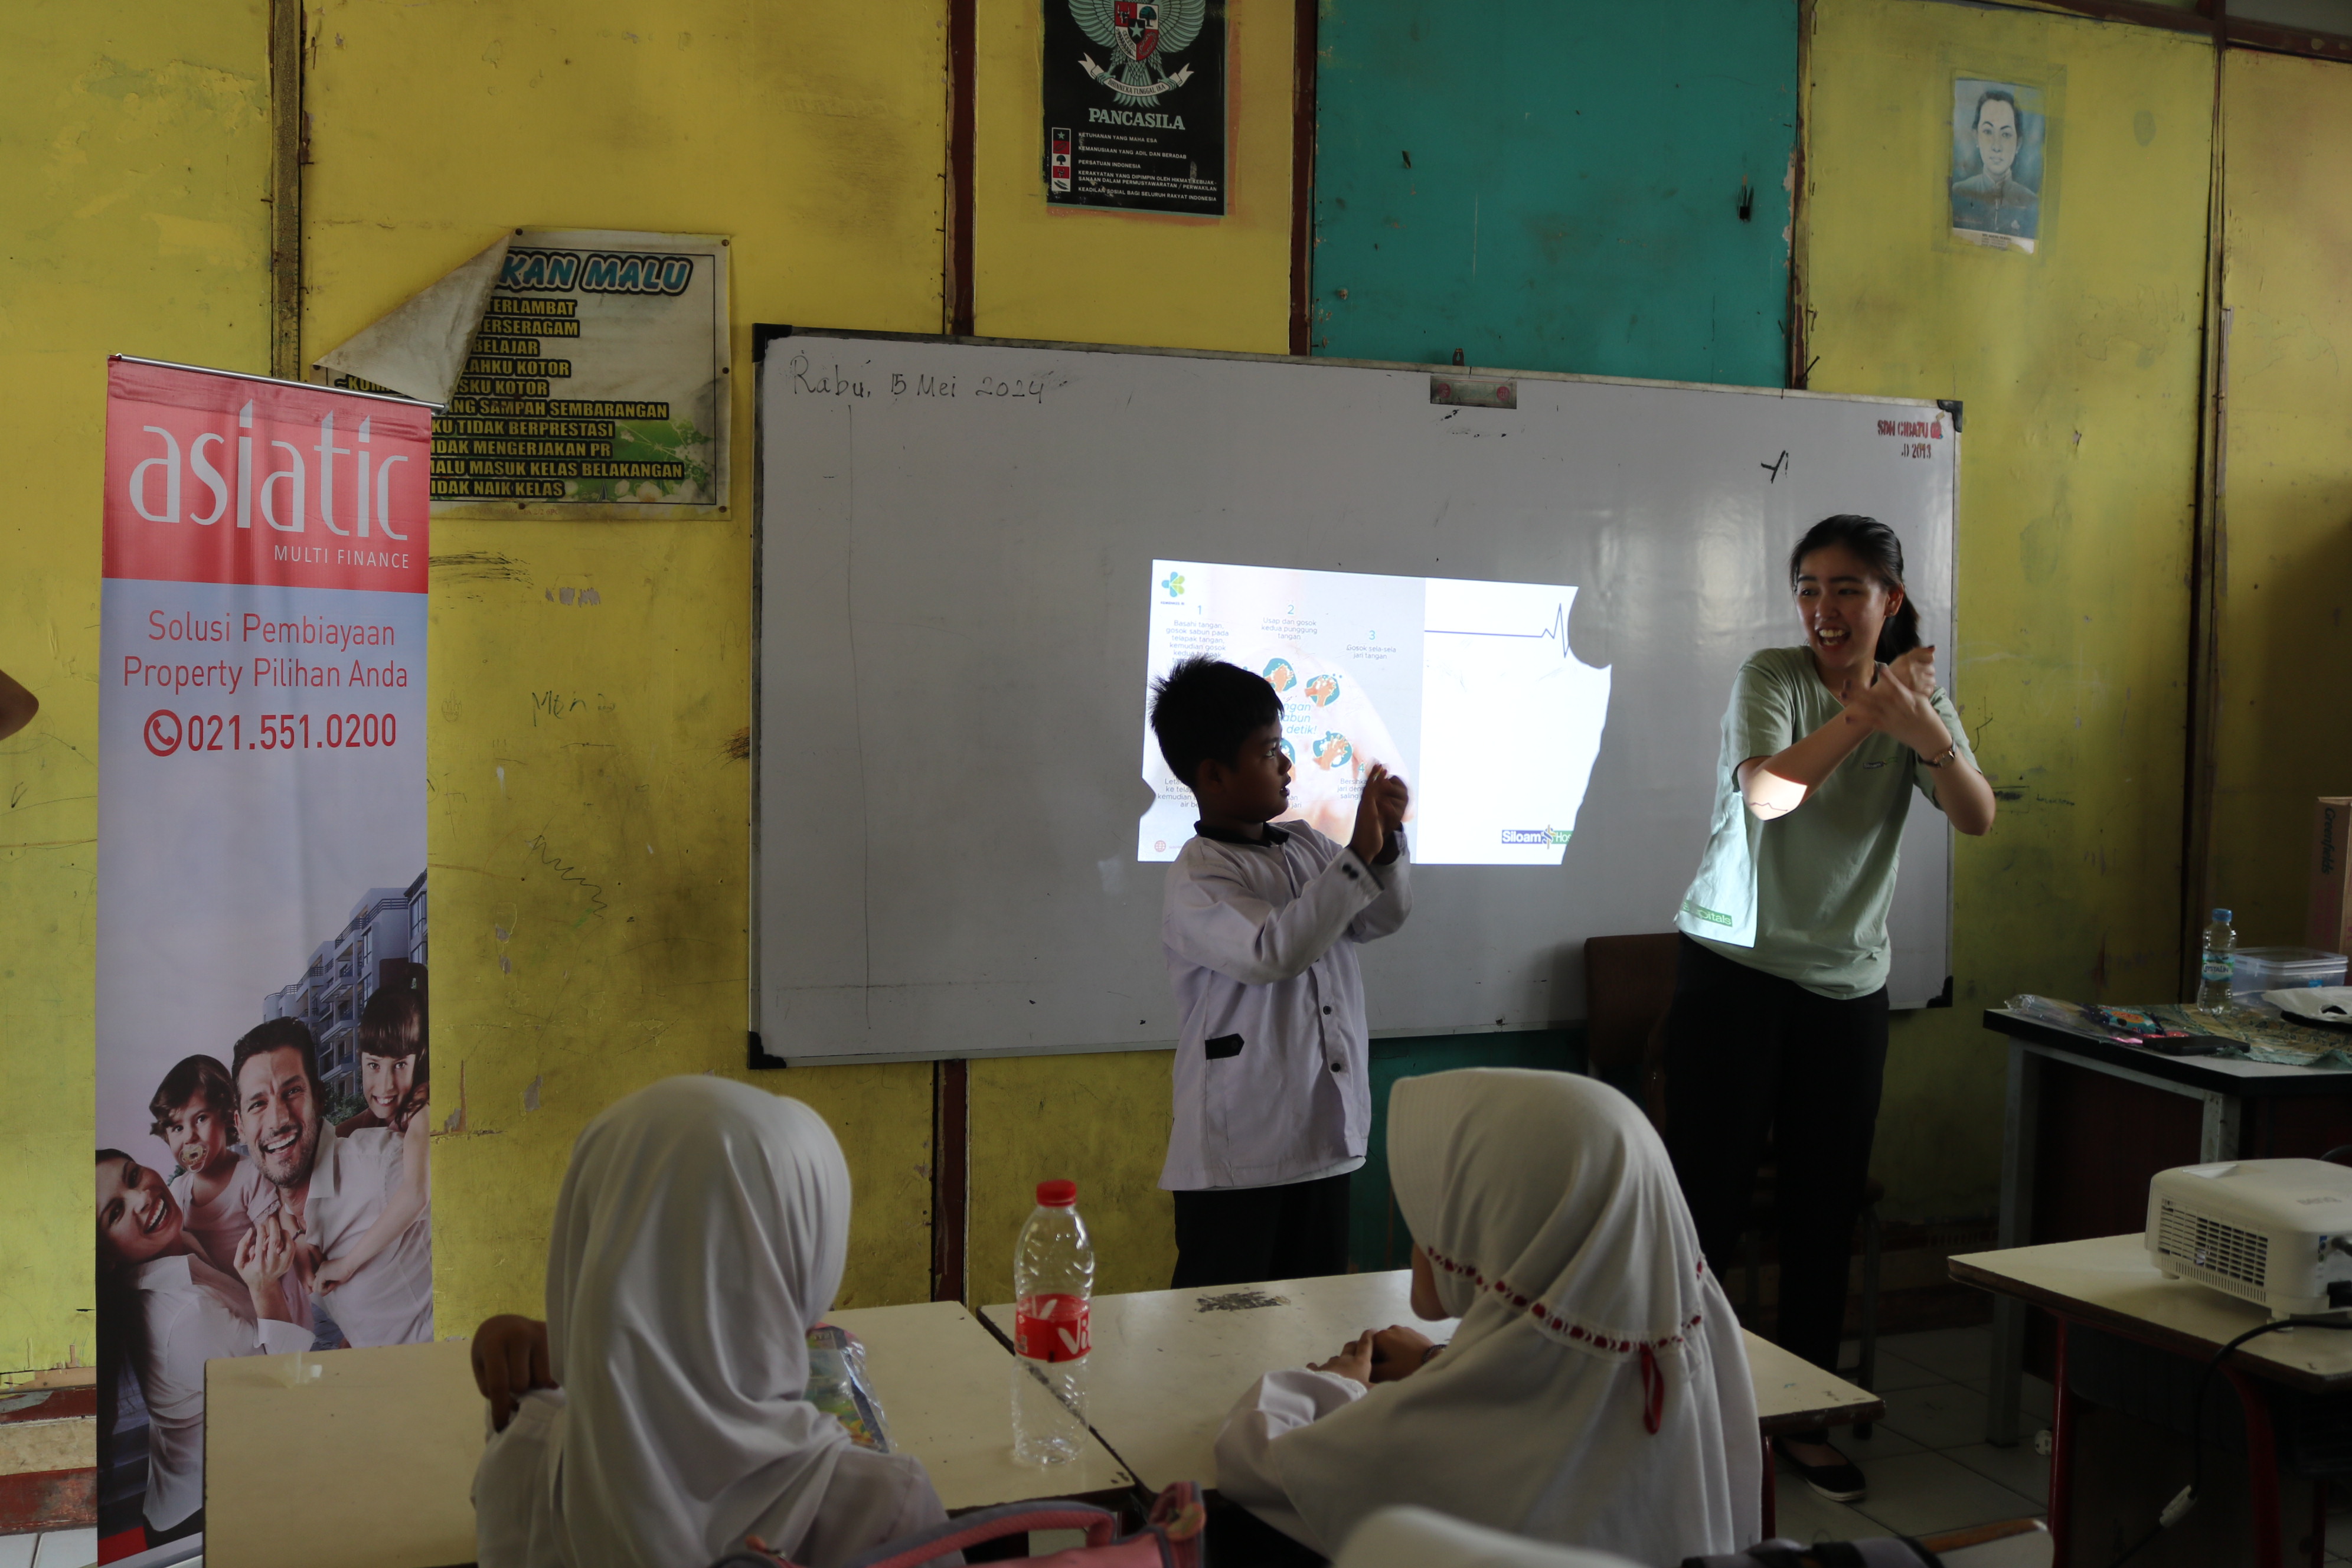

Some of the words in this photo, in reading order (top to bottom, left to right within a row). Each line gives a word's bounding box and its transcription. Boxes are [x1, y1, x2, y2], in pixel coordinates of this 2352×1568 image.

[1108, 79, 1132, 94] BHINNEKA
[1089, 108, 1185, 130] PANCASILA
[1122, 179, 1177, 188] PERMUSYAWARATAN
[583, 256, 690, 293] MALU
[481, 319, 579, 336] ERSERAGAM
[472, 338, 539, 355] BELAJAR
[463, 358, 513, 374] AHKU
[517, 360, 570, 375] KOTOR
[456, 379, 491, 394] SKU
[495, 380, 548, 396] KOTOR
[917, 373, 956, 398] Mei
[975, 376, 1044, 404] 2024
[479, 399, 546, 415] SAMPAH
[550, 402, 668, 419] SEMBARANGAN
[457, 420, 505, 435] TIDAK
[509, 421, 613, 437] BERPRESTASI
[1877, 420, 1896, 436] SDN
[473, 440, 586, 456] MENGERJAKAN
[590, 442, 611, 457] PR
[129, 398, 409, 540] asiatic
[469, 460, 527, 476] MASUK
[531, 462, 577, 476] KELAS
[582, 462, 682, 478] BELAKANGAN
[473, 481, 512, 495] NAIK
[515, 481, 563, 496] KELAS
[274, 545, 329, 564] MULTI
[337, 550, 409, 569] FINANCE
[1197, 605, 1202, 615] 1
[1287, 604, 1295, 615] 2
[1198, 621, 1224, 629] tangan,
[1263, 617, 1280, 625] Usap
[149, 610, 230, 642] Solusi
[243, 613, 394, 652] Pembiayaan
[1283, 626, 1318, 635] punggung
[1368, 630, 1376, 641] 3
[124, 655, 243, 694] Property
[254, 658, 340, 687] Pilihan
[349, 659, 408, 687] Anda
[187, 713, 396, 751] 021.551.0200
[1286, 725, 1318, 734] detik!
[1358, 763, 1365, 772] 4
[1502, 830, 1541, 843] Siloam
[2321, 807, 2336, 875] Greenfields
